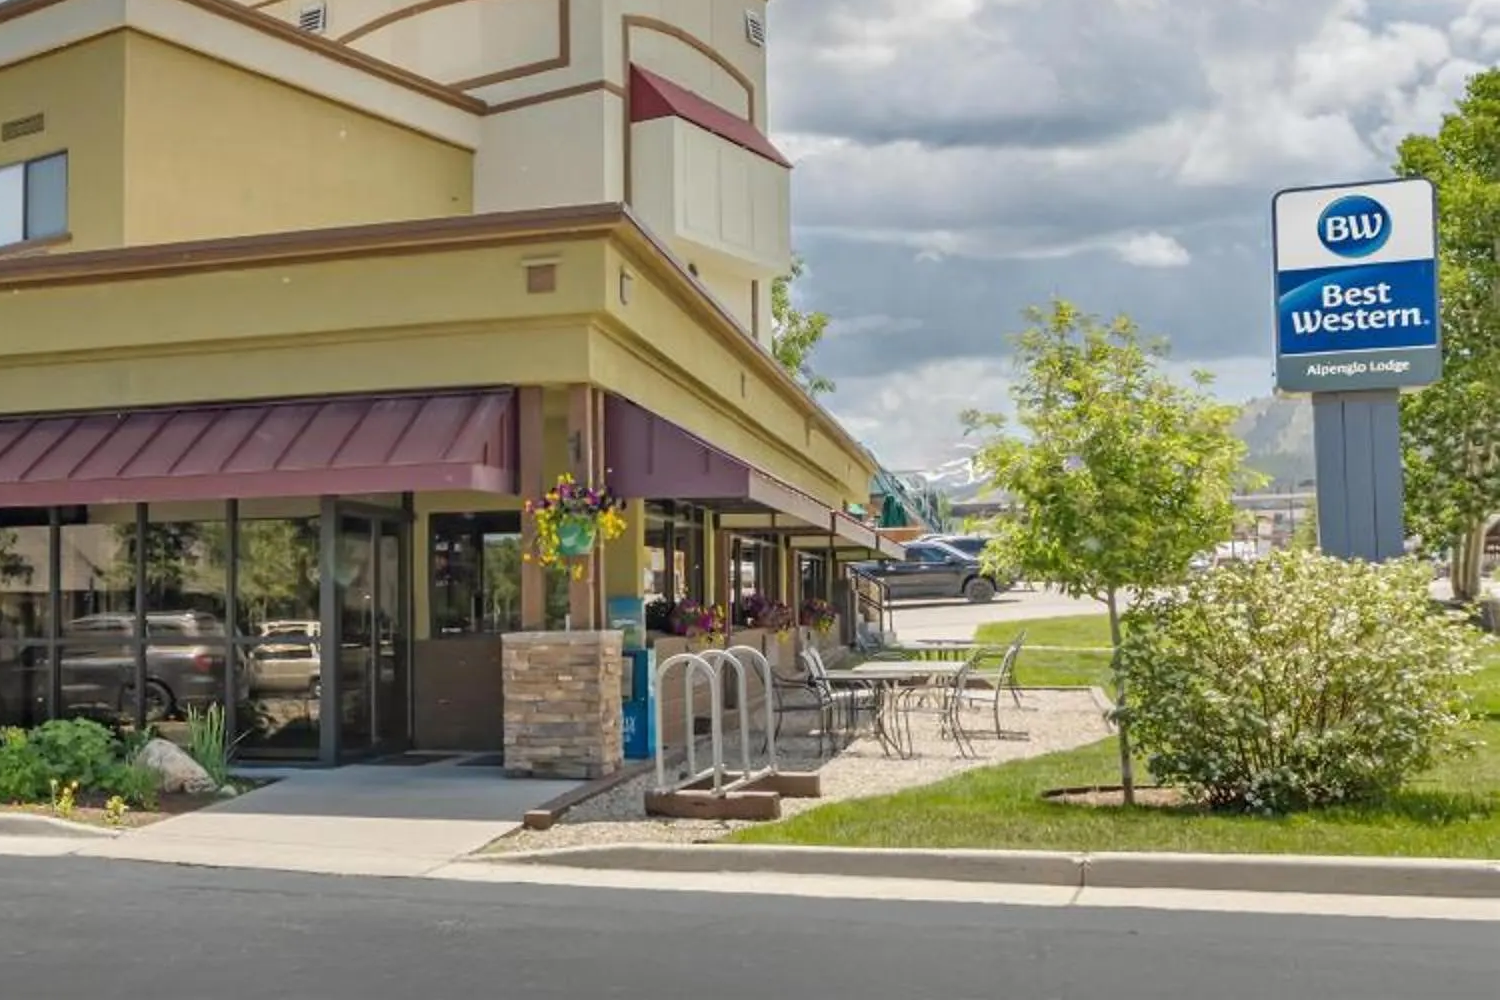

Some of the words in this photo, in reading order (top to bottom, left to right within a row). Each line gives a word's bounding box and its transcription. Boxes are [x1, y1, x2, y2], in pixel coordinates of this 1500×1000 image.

[1326, 214, 1382, 242] BW
[1322, 283, 1391, 307] Best
[1306, 361, 1367, 377] Alpenglo
[1370, 360, 1410, 373] Lodge
